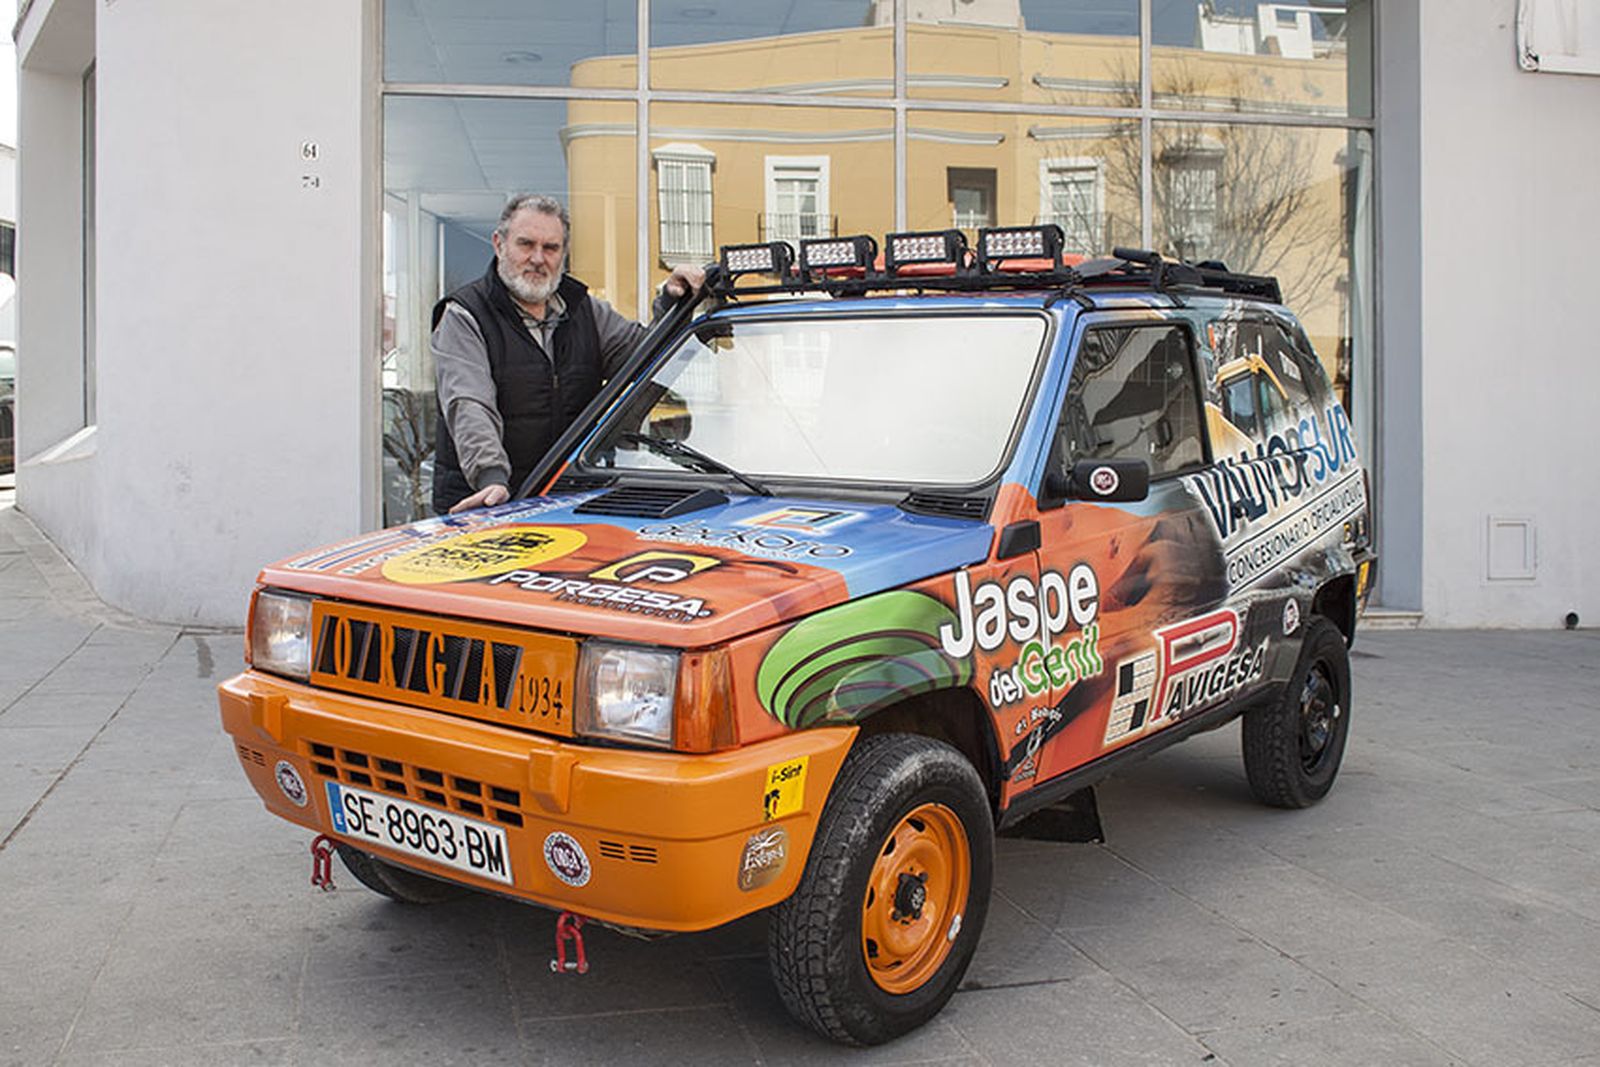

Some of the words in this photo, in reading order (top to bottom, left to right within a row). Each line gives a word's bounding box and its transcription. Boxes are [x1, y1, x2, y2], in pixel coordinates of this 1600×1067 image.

[940, 565, 1098, 658] Jaspe
[333, 616, 498, 706] ORGA
[518, 673, 564, 725] 1934
[990, 665, 1023, 706] del
[1018, 624, 1102, 694] Genil
